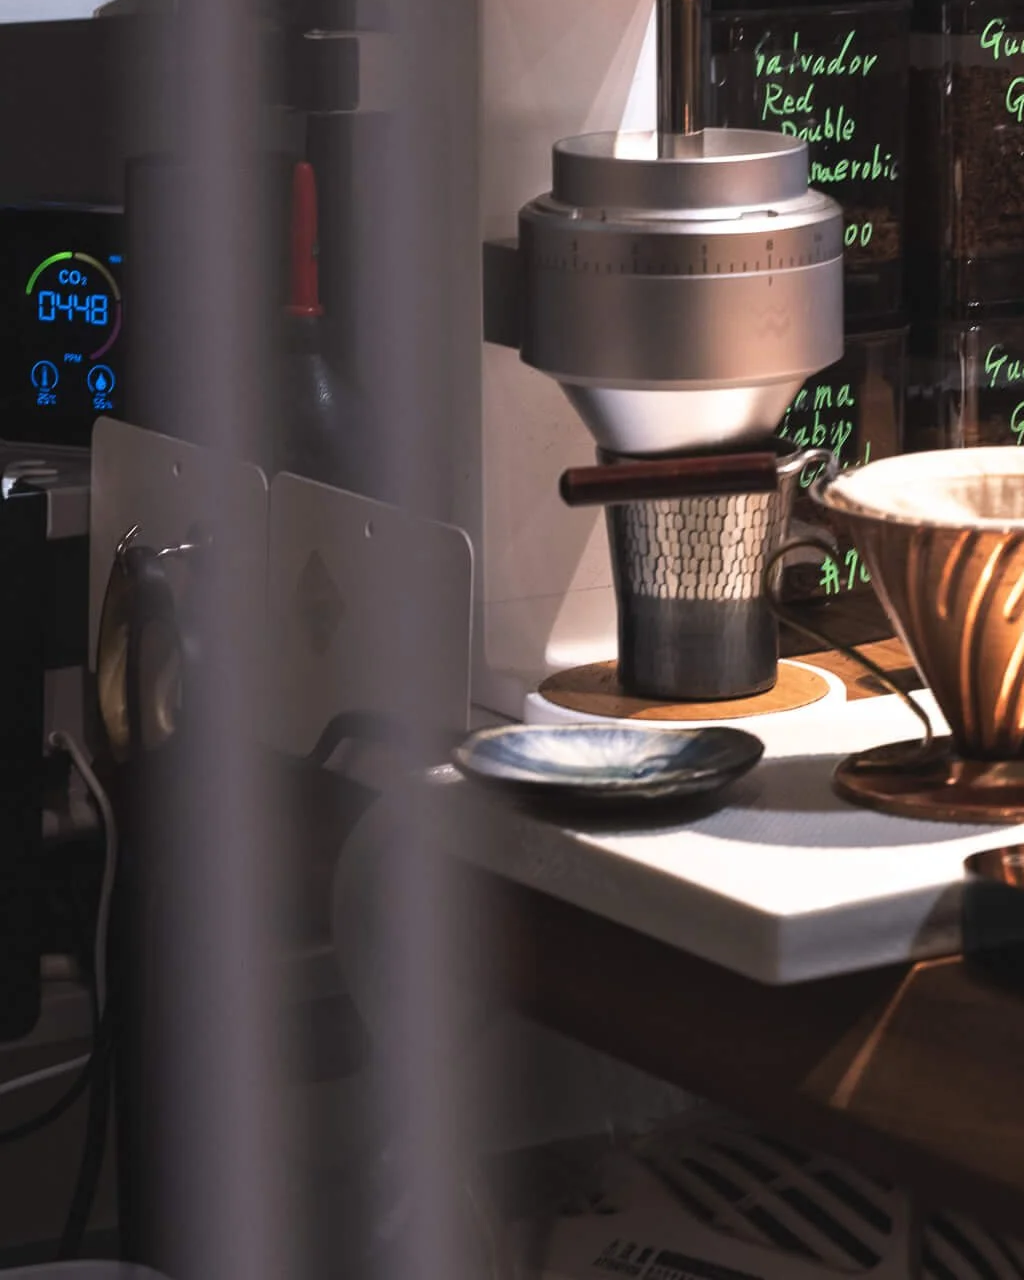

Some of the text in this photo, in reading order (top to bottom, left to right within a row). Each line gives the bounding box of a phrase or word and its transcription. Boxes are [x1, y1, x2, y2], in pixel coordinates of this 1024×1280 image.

[761, 83, 815, 120] Red
[807, 144, 899, 184] naerobic
[38, 291, 108, 325] 0448
